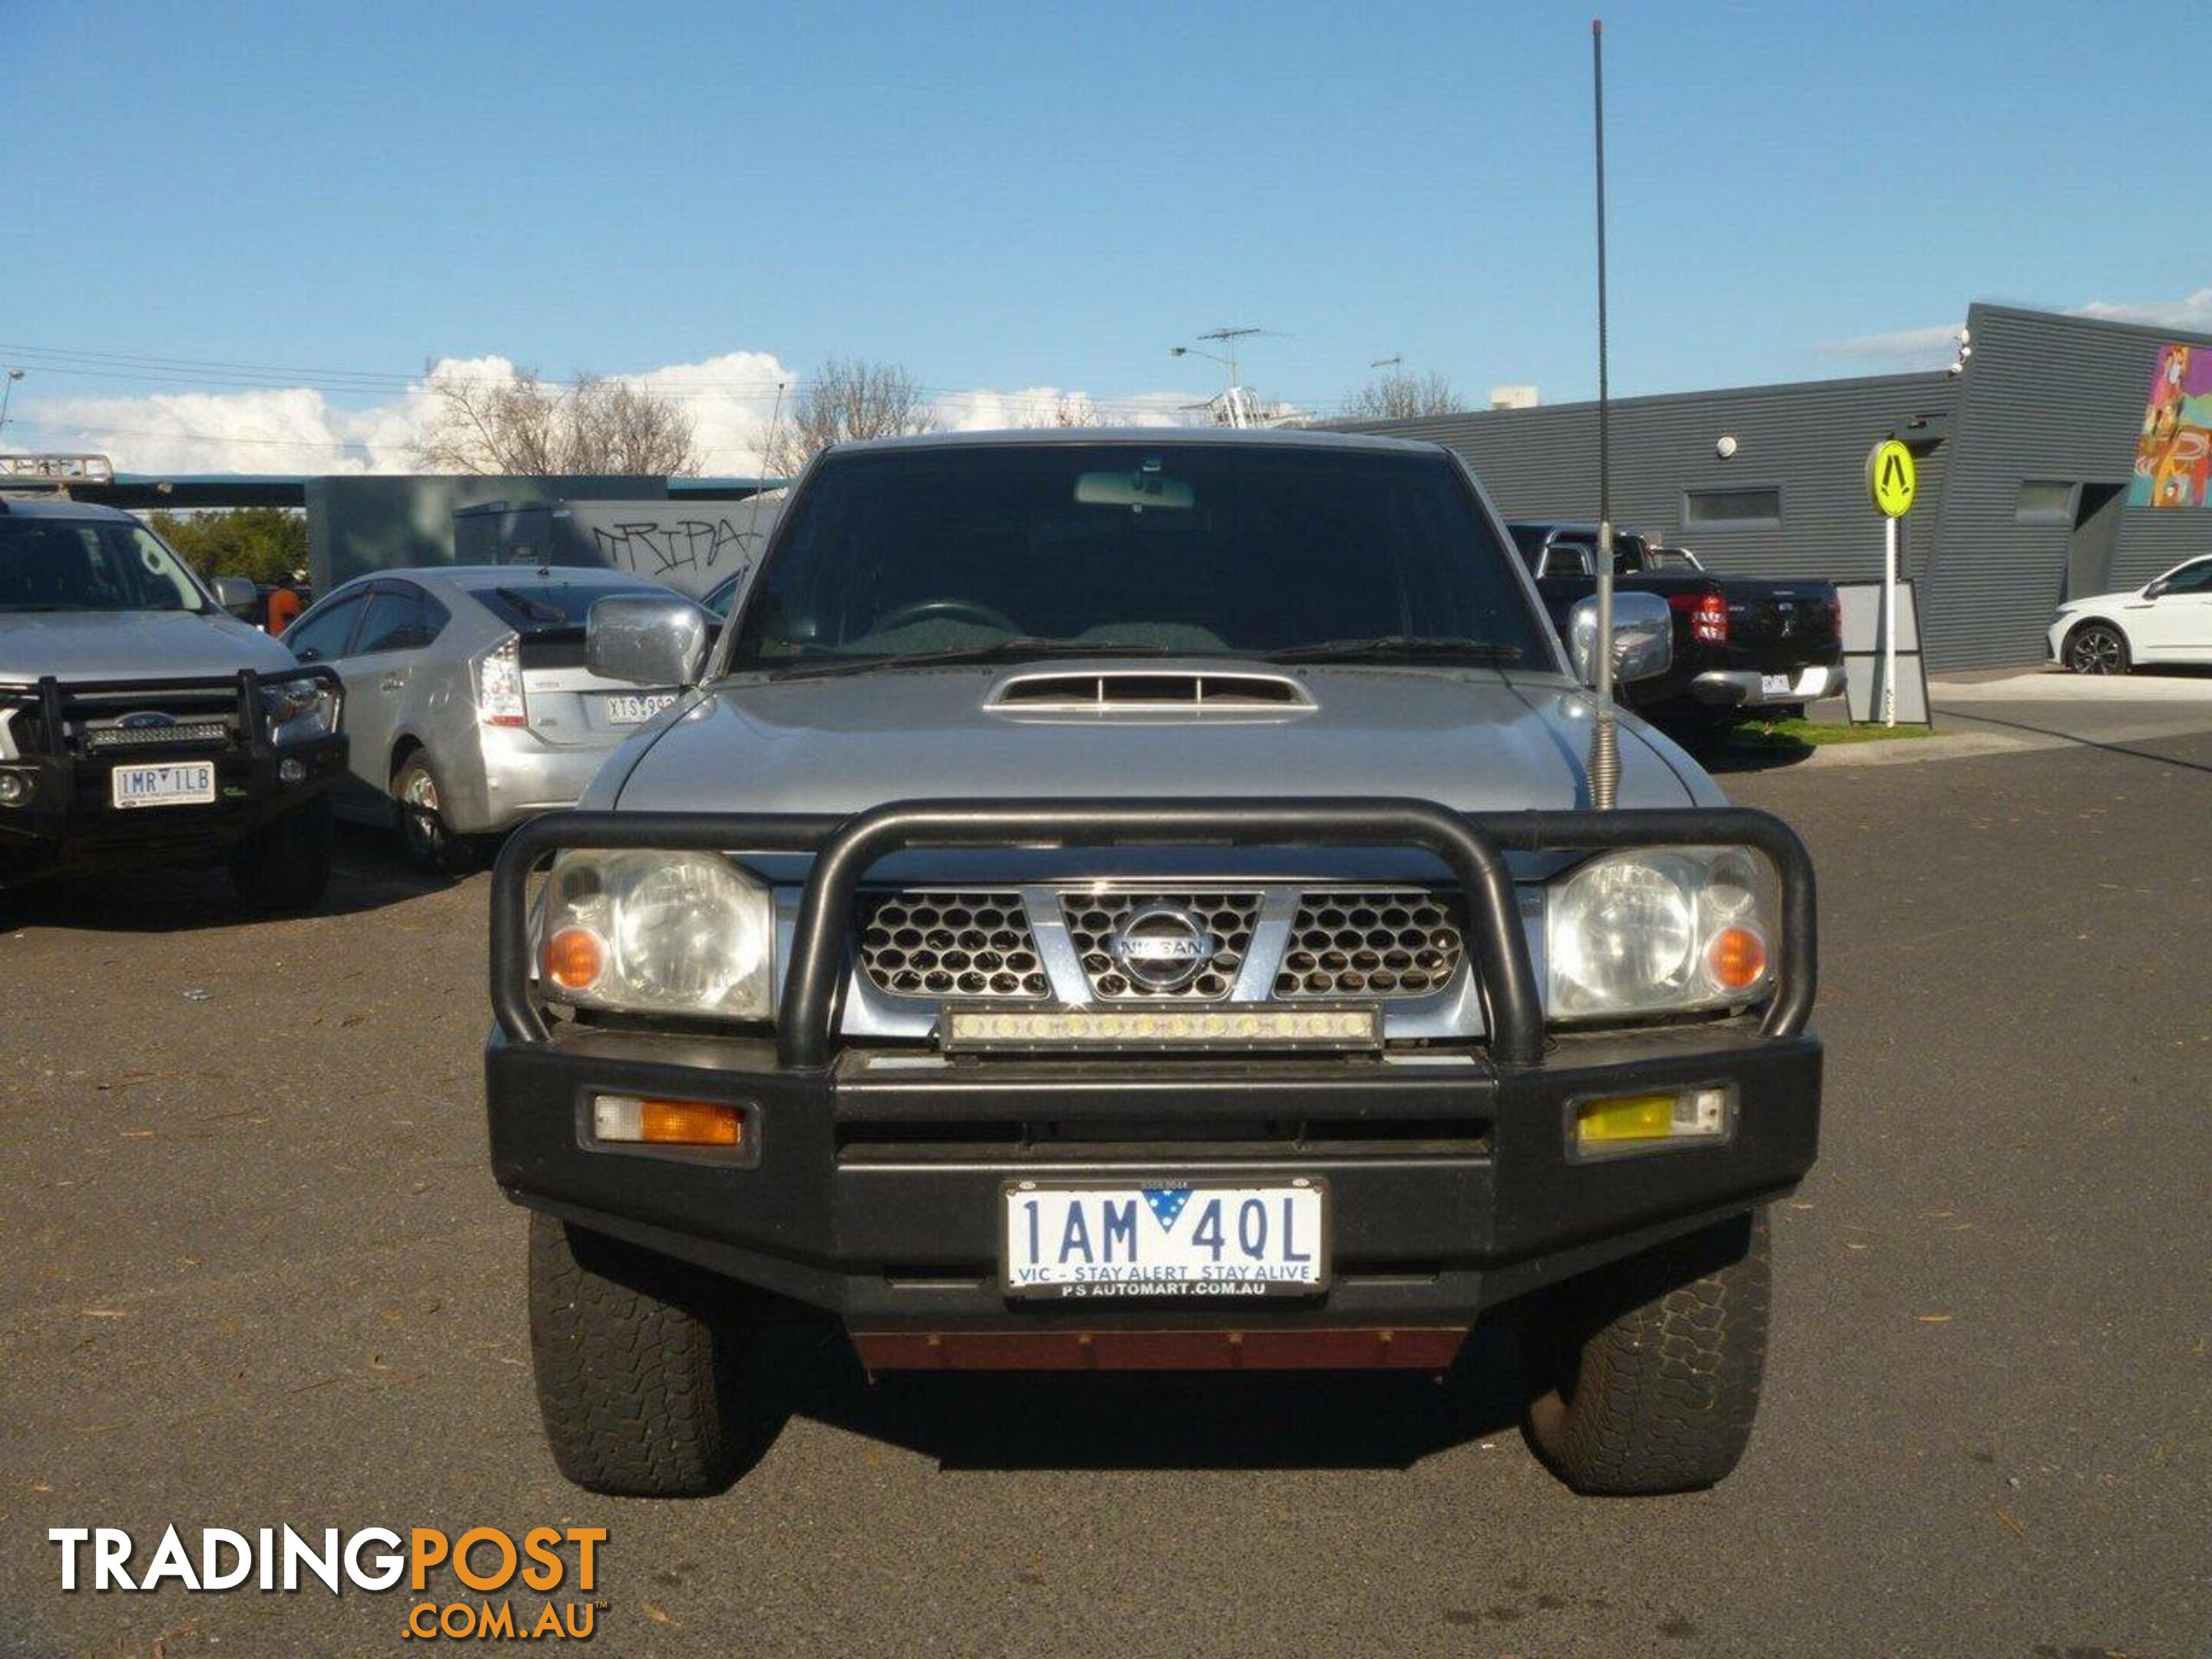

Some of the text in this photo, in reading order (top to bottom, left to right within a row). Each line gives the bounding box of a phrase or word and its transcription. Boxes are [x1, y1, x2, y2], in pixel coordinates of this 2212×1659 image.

[123, 769, 209, 793] 1MR 1LB
[1121, 941, 1202, 954] NISAN
[1024, 1198, 1310, 1263] 1AM 4QL
[1019, 1268, 1050, 1281] VIC
[1075, 1267, 1122, 1281] STAY
[1129, 1267, 1188, 1281] ALERT
[1202, 1267, 1248, 1280] STAY
[1255, 1267, 1310, 1280] ALIVE
[1092, 1282, 1266, 1296] AUTOMART.COM.AU
